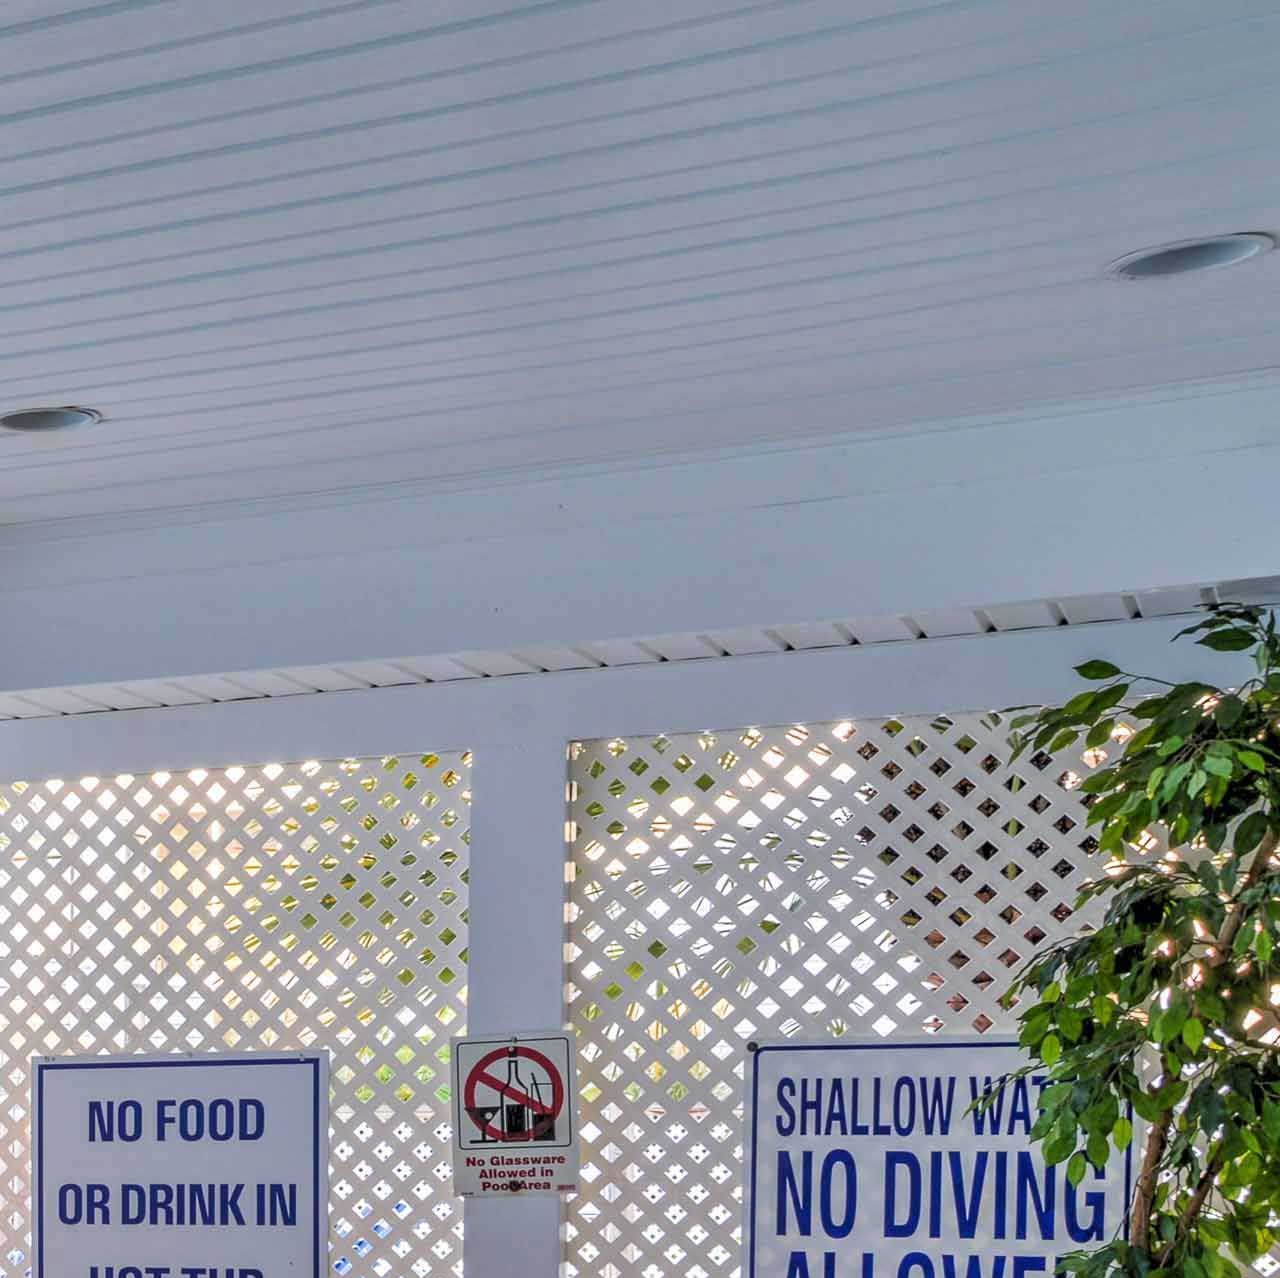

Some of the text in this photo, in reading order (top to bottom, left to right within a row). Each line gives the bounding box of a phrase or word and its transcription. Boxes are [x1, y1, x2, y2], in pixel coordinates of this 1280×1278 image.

[87, 1098, 266, 1143] NO FOOD
[775, 1076, 956, 1137] SHALLOW
[465, 1155, 566, 1167] No Glassware
[479, 1167, 554, 1179] Allowed in
[57, 1182, 298, 1227] OR DRINK IN
[482, 1181, 514, 1192] Poo
[519, 1180, 551, 1191] Area
[776, 1148, 1106, 1243] NO DIVING
